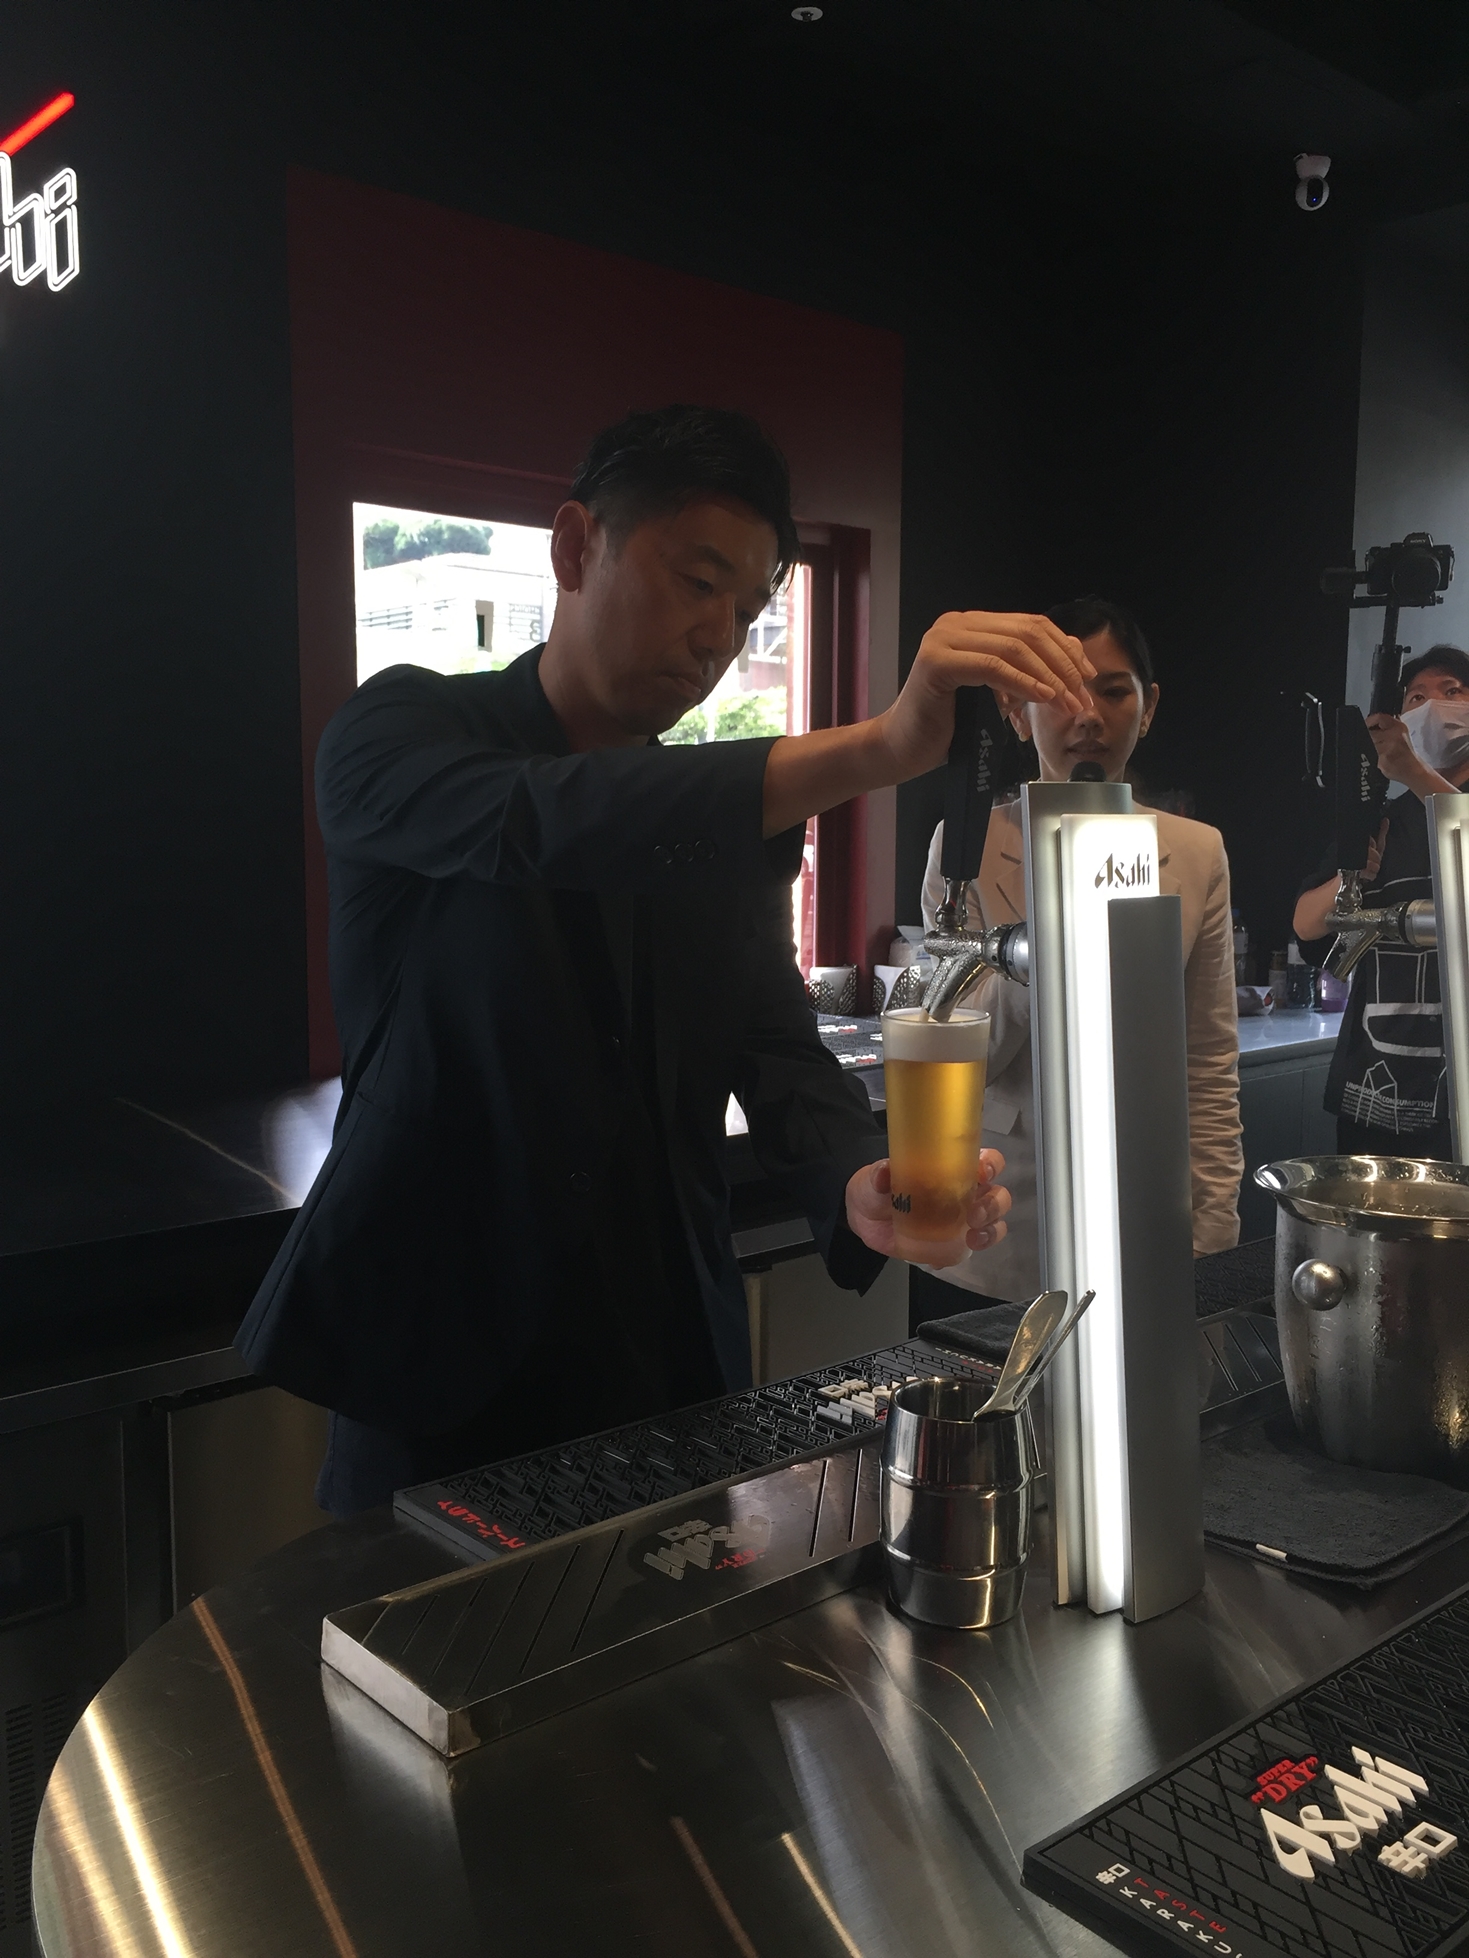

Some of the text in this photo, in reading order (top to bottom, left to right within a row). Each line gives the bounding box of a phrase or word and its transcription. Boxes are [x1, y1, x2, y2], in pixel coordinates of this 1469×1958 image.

[976, 728, 993, 793] Asahi
[1094, 853, 1151, 889] Asahi
[1256, 1759, 1296, 1787] SUPER
[1260, 1745, 1430, 1883] Asahi
[1377, 1821, 1459, 1880] 辛口
[1133, 1877, 1227, 1933] TASTE
